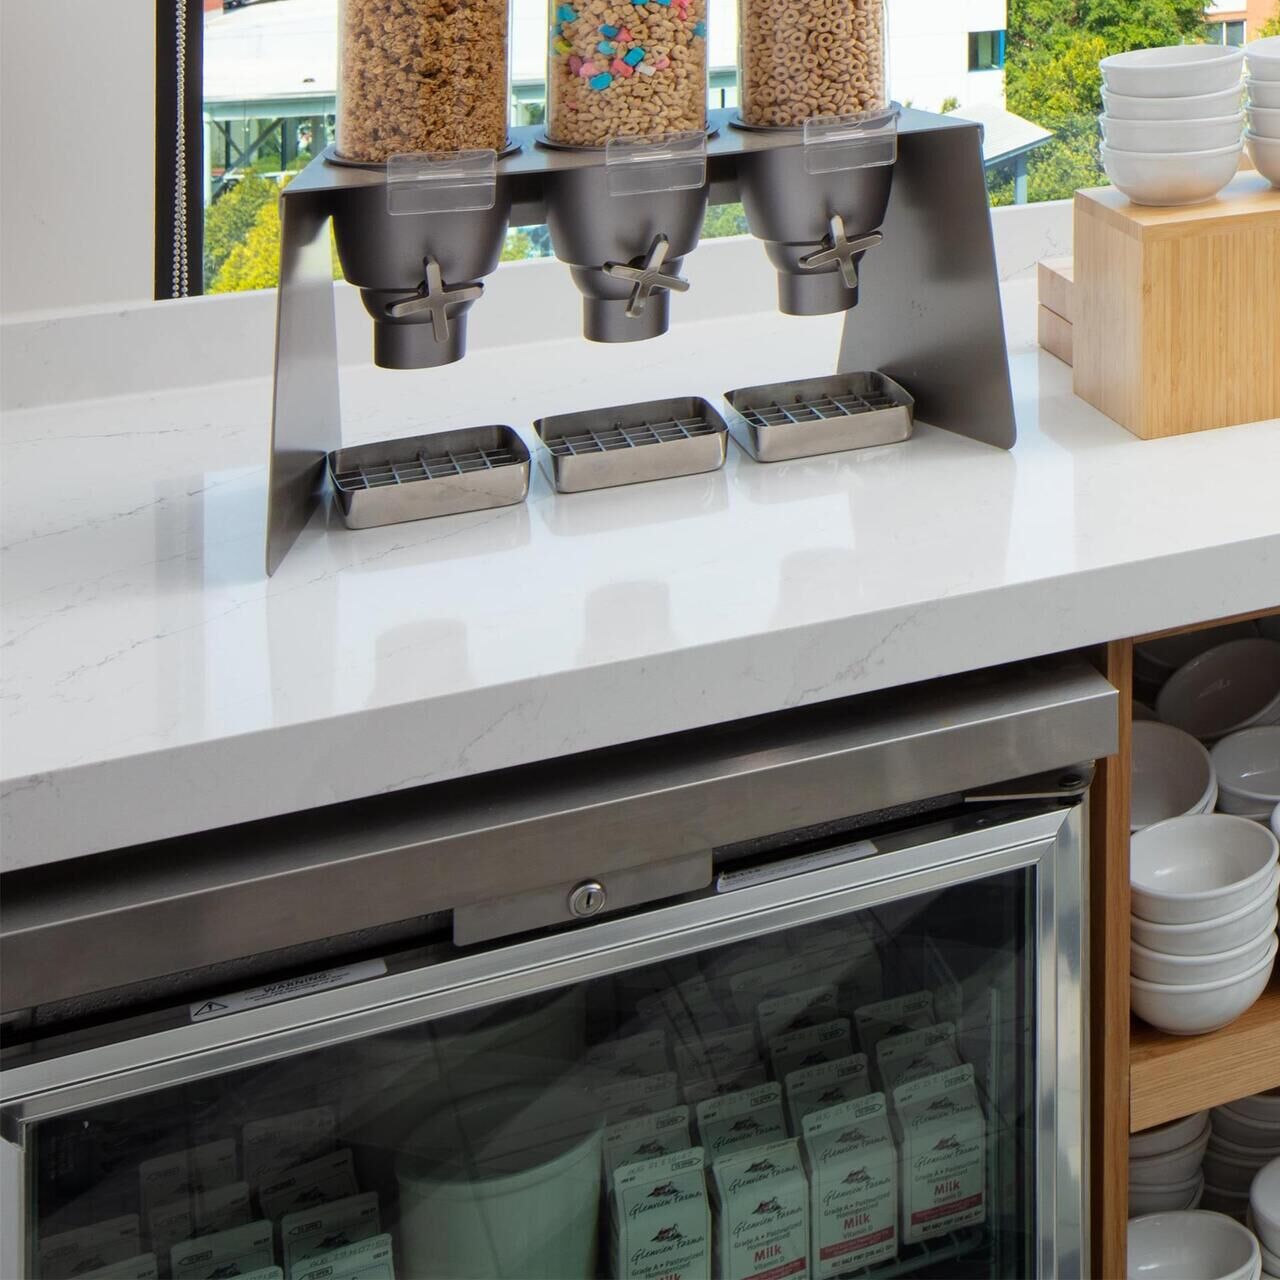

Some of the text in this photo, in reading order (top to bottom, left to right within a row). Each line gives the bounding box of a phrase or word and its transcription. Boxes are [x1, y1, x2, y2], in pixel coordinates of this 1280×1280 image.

[933, 1180, 961, 1197] Milk
[844, 1212, 871, 1231] Milk
[753, 1244, 782, 1262] Milk
